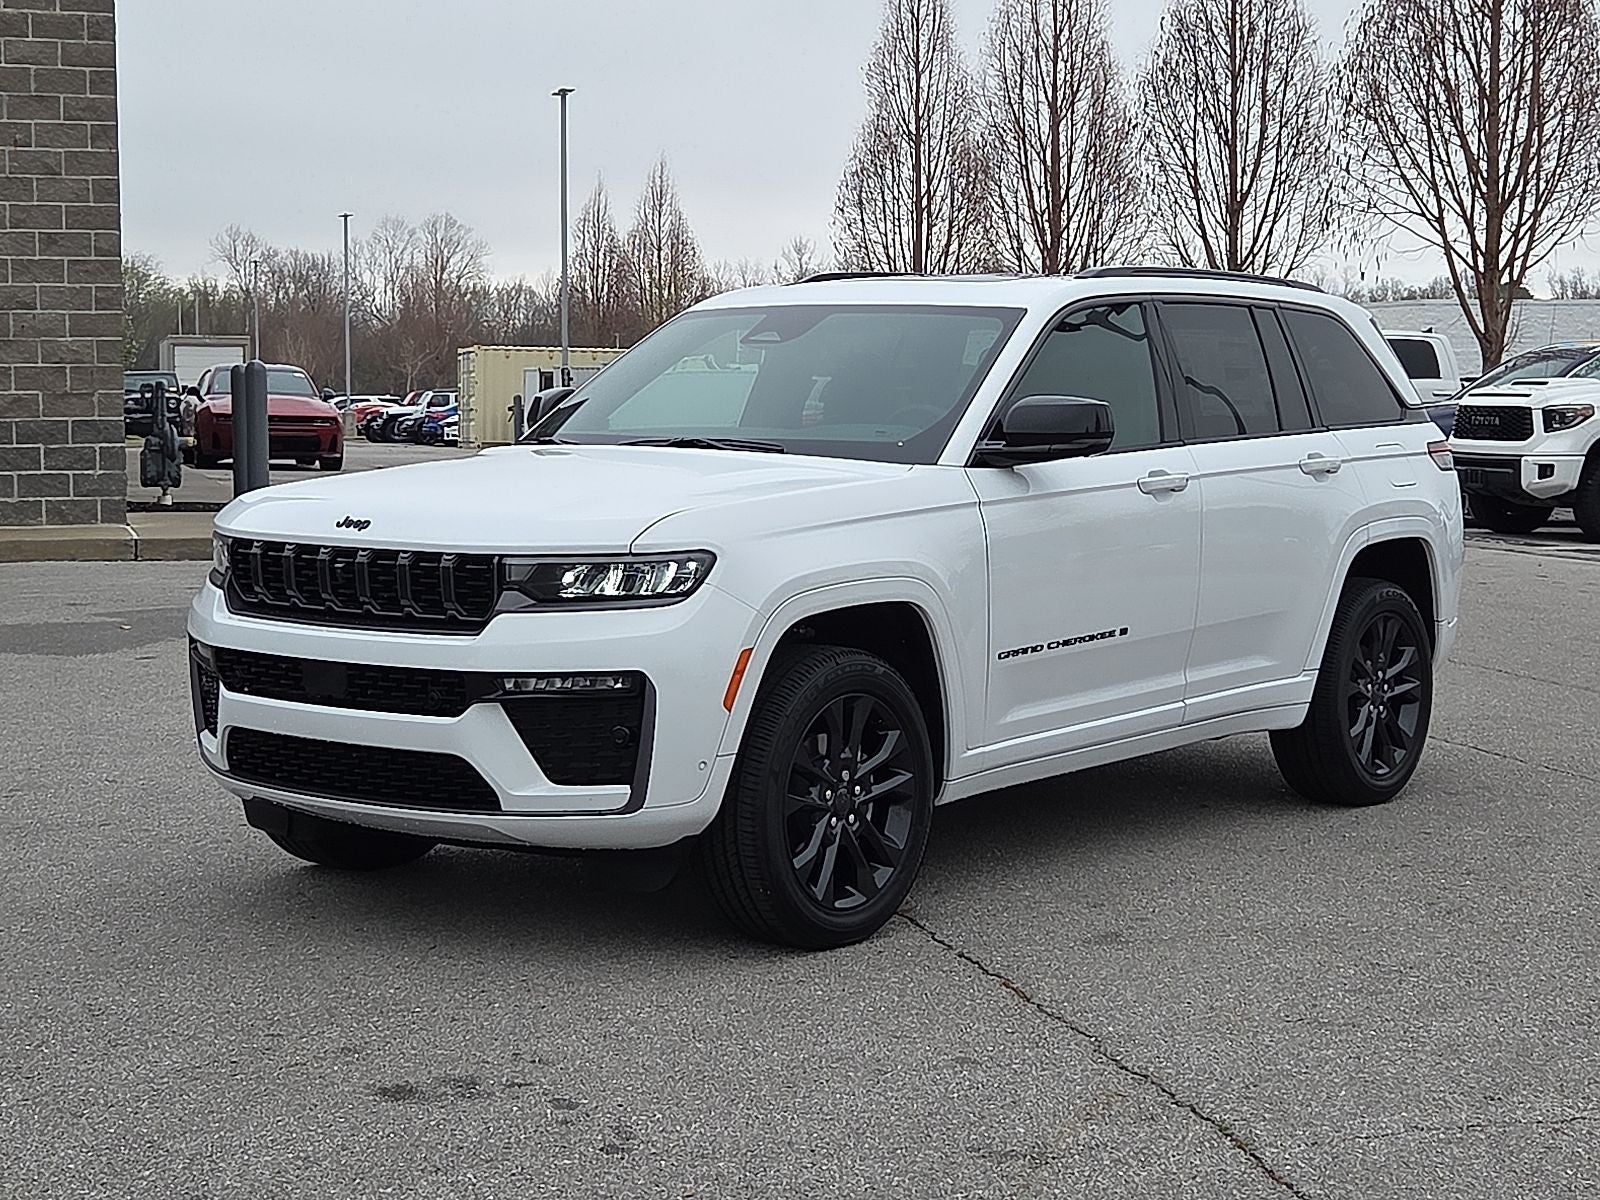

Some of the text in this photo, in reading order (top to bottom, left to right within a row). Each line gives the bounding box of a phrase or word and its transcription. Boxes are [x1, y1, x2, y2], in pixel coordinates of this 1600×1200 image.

[1470, 416, 1500, 425] TOYOTA
[336, 516, 371, 531] Jeep
[997, 629, 1116, 660] GRAND CHEROKEE
